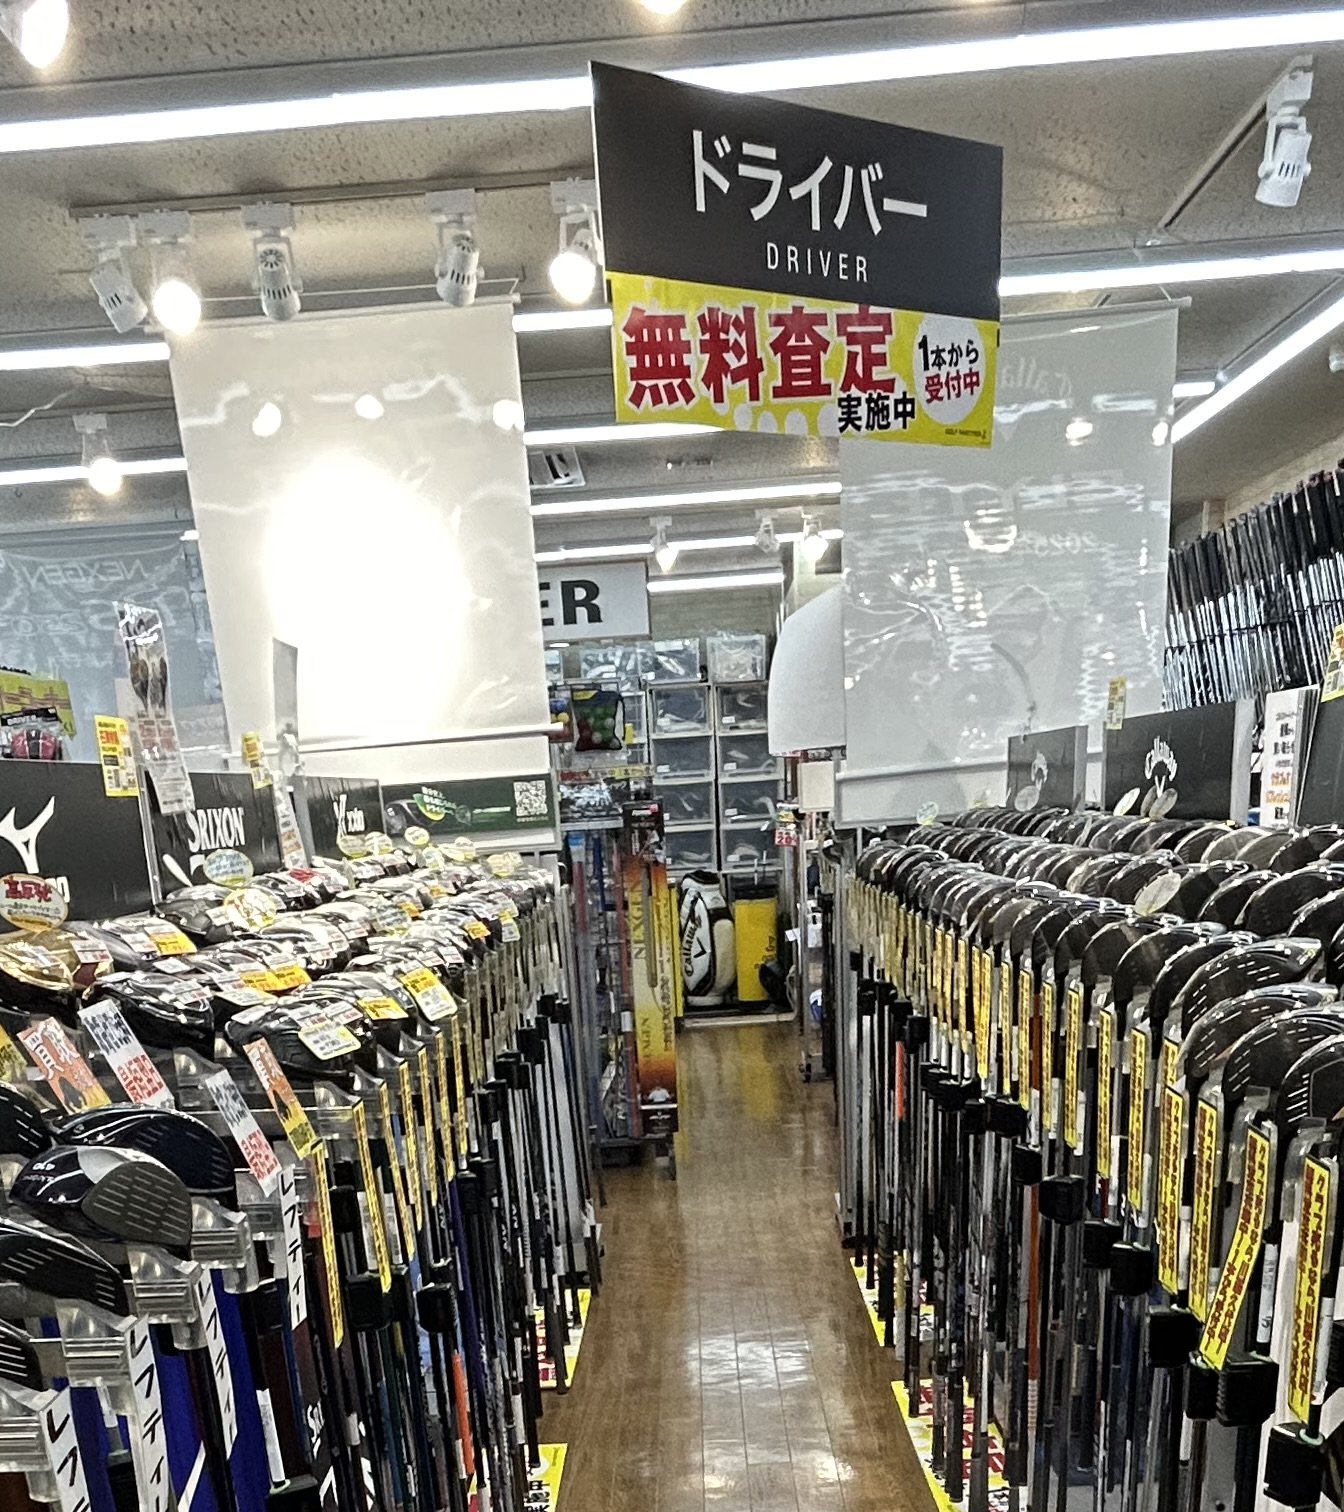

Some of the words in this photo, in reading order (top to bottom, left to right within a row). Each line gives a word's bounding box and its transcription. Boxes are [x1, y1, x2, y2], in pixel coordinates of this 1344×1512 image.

[692, 130, 927, 236] ドライバー
[766, 242, 869, 284] DRIVER
[622, 305, 896, 409] 無料査定
[918, 335, 979, 372] 1本から
[925, 367, 981, 403] 受付中
[837, 391, 916, 433] 実施中
[184, 806, 246, 853] SRIXON
